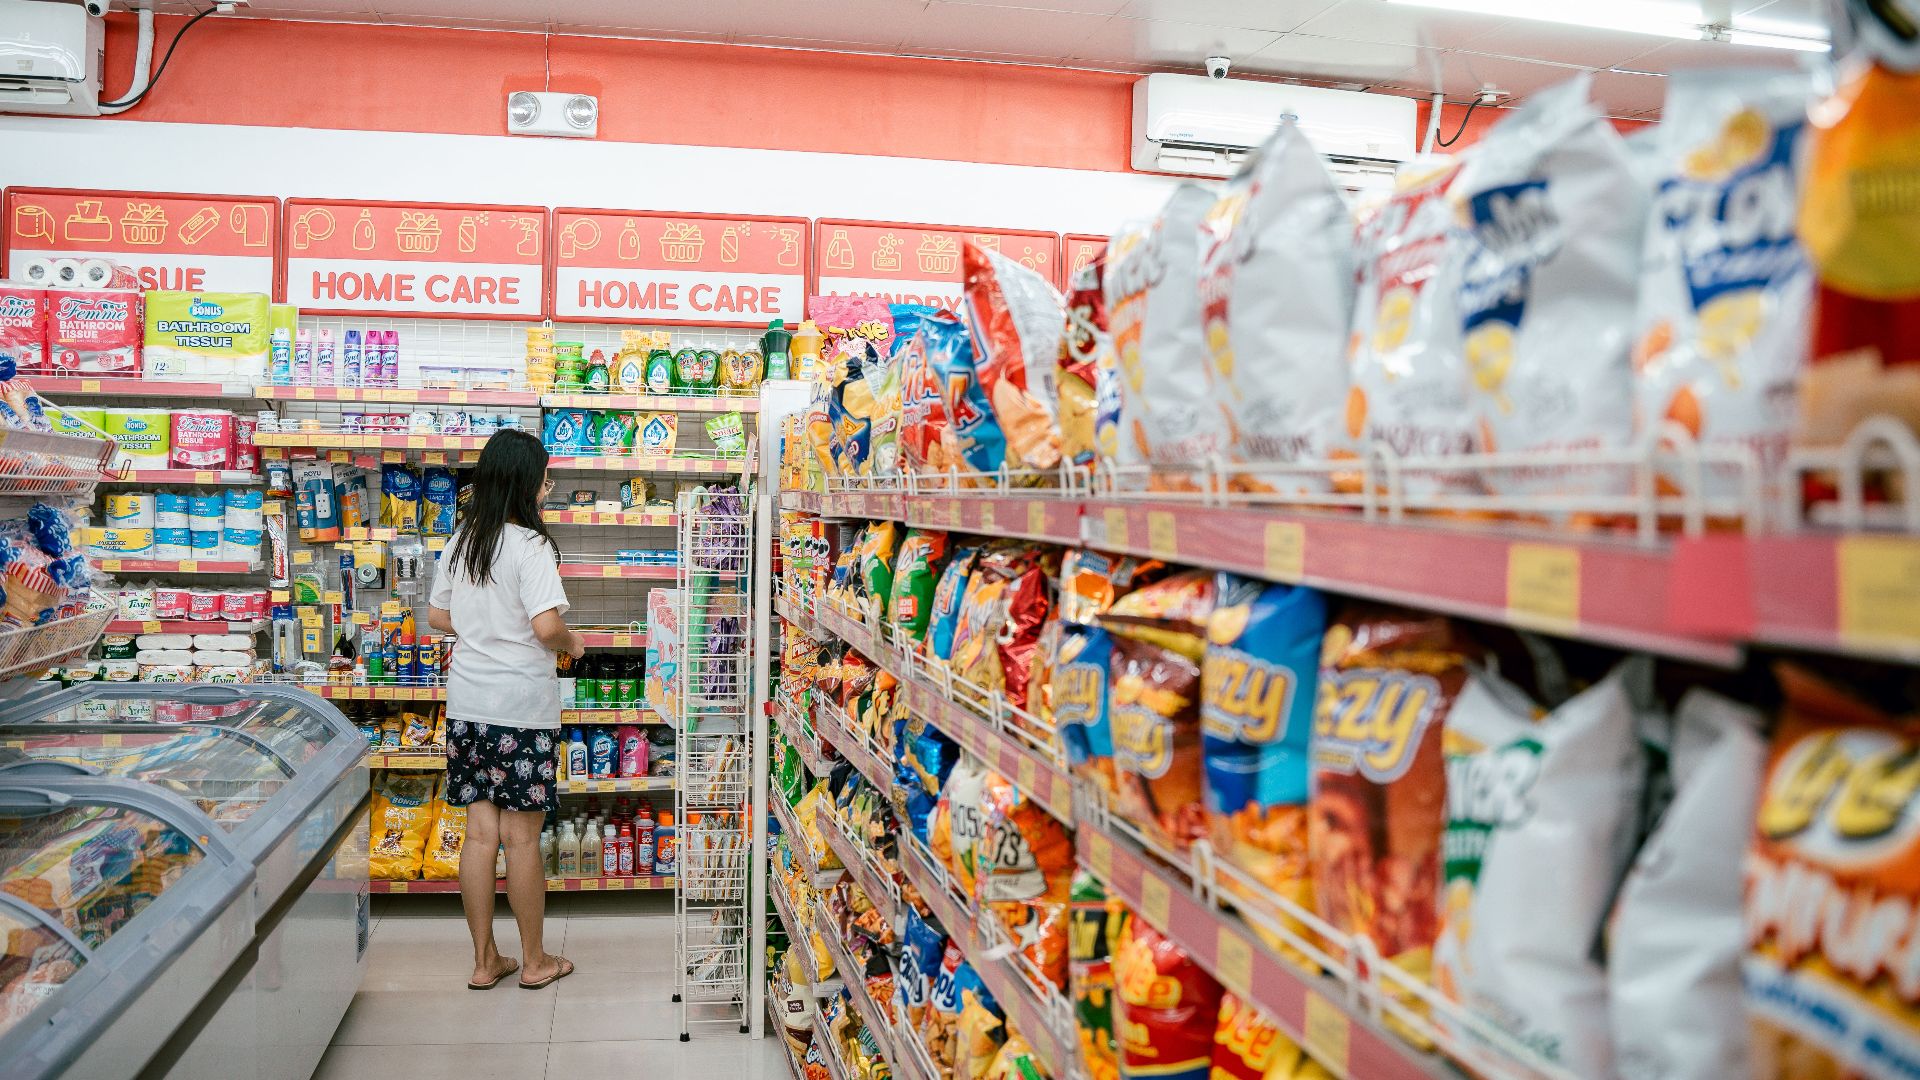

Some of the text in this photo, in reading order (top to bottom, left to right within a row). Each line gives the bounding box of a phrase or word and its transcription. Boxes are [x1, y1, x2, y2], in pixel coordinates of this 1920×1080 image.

[312, 270, 521, 305] HOME CARE
[578, 279, 781, 314] HOME CARE
[192, 305, 223, 317] BONUS
[59, 321, 126, 331] BATHROOM
[157, 321, 251, 334] BATHROOM
[58, 330, 98, 339] TISSUE
[175, 336, 233, 347] TISSUE
[177, 430, 221, 438] BATHROOM
[391, 797, 421, 806] BONUS
